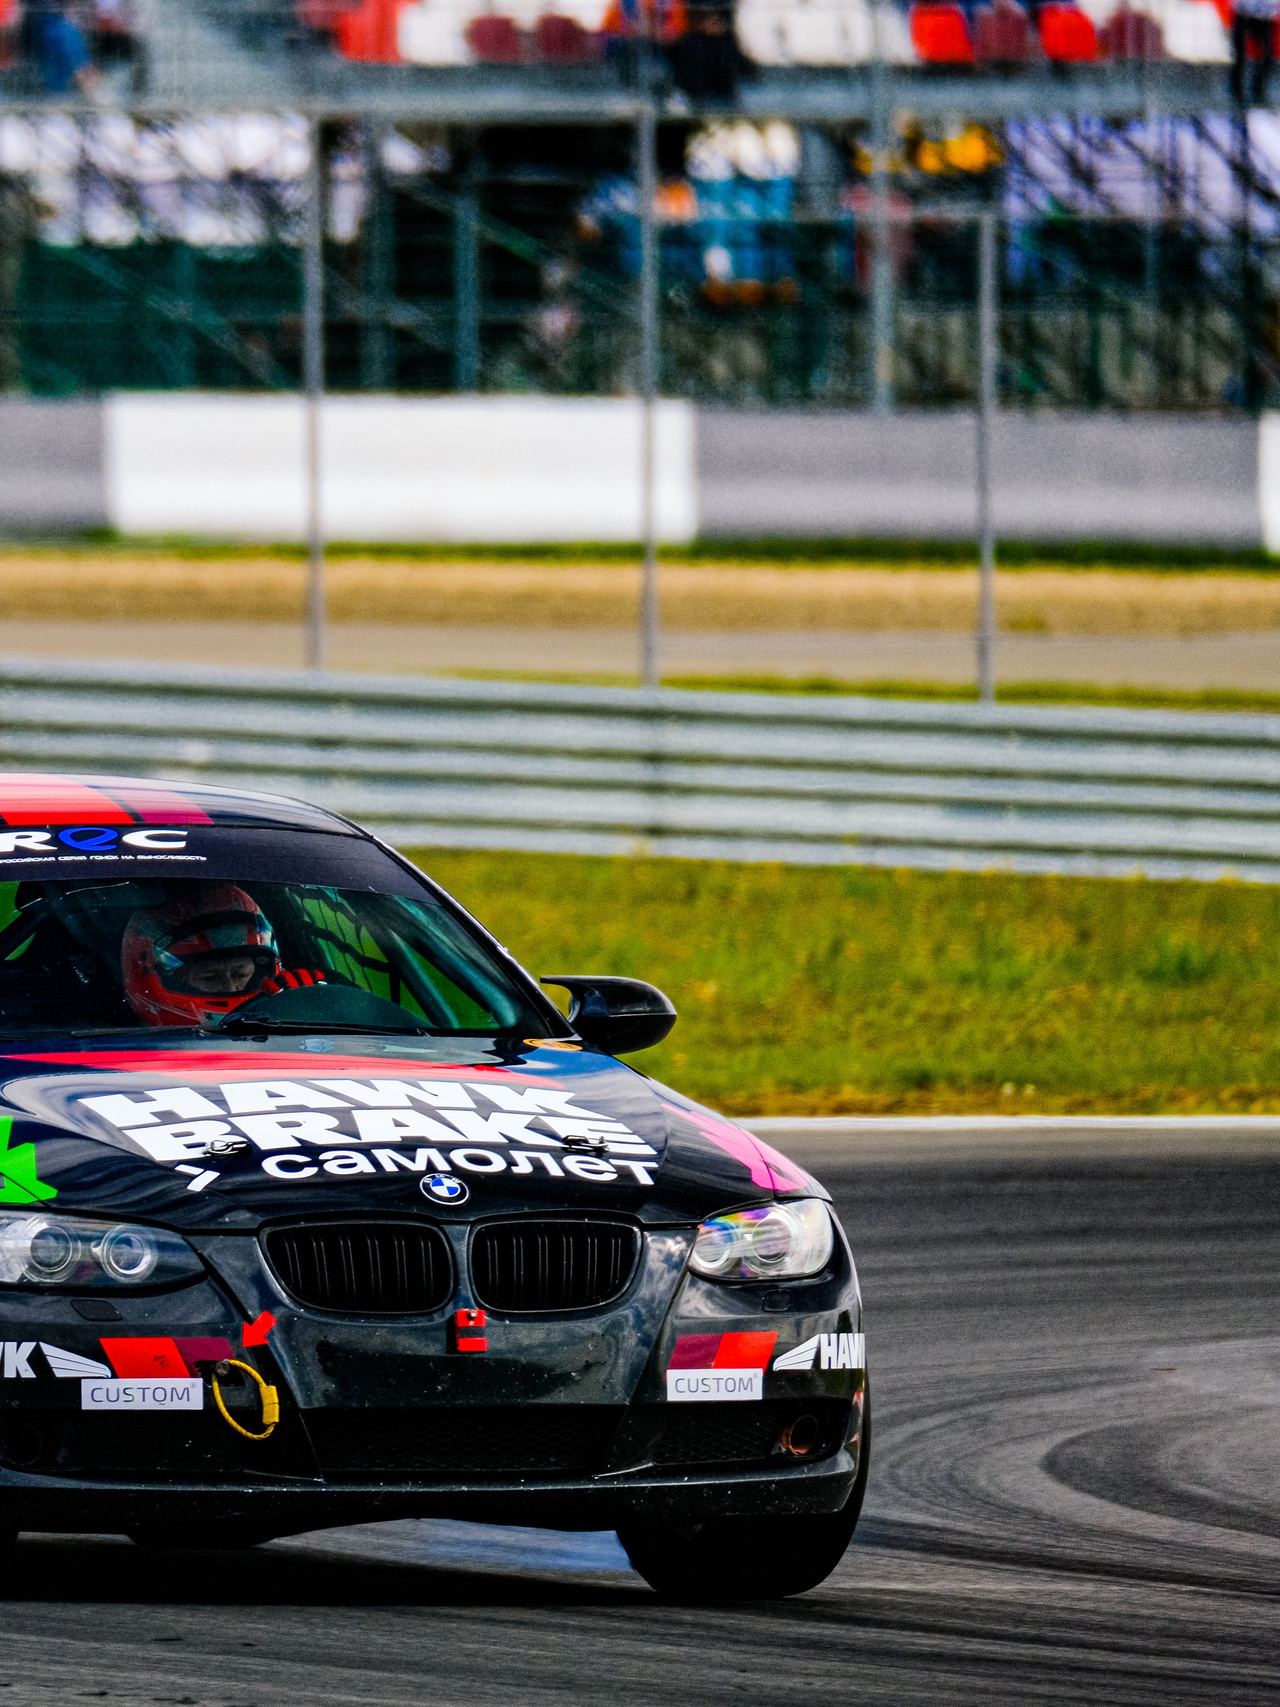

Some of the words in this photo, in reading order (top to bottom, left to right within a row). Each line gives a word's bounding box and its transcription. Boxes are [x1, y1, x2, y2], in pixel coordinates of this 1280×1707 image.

[78, 1078, 618, 1128] HAWK
[122, 1108, 658, 1162] BRAKE
[261, 1147, 659, 1186] самолет
[820, 1333, 866, 1369] HAW
